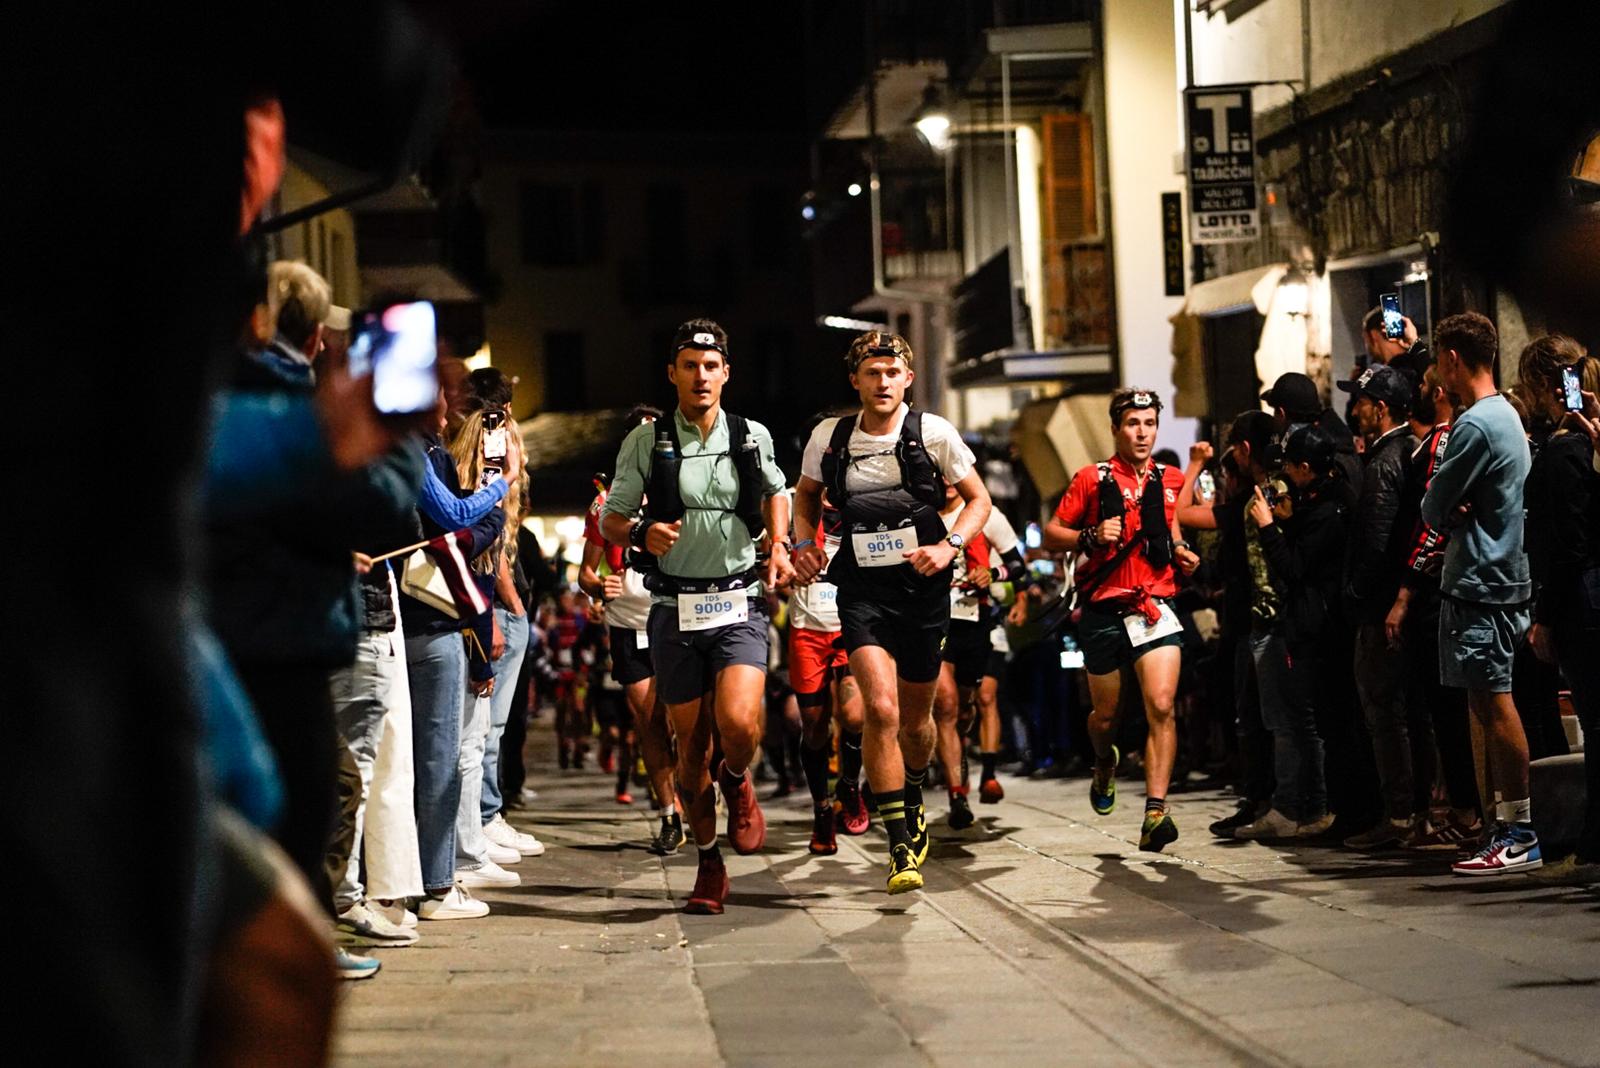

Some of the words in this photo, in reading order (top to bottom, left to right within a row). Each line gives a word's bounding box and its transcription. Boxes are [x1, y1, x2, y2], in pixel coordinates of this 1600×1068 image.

[1196, 94, 1242, 153] T
[1192, 165, 1252, 181] TABACCHI
[1199, 213, 1251, 227] LOTTO
[875, 533, 890, 541] TDS
[867, 538, 904, 553] 9016
[704, 594, 720, 603] TDS
[694, 601, 733, 614] 9009
